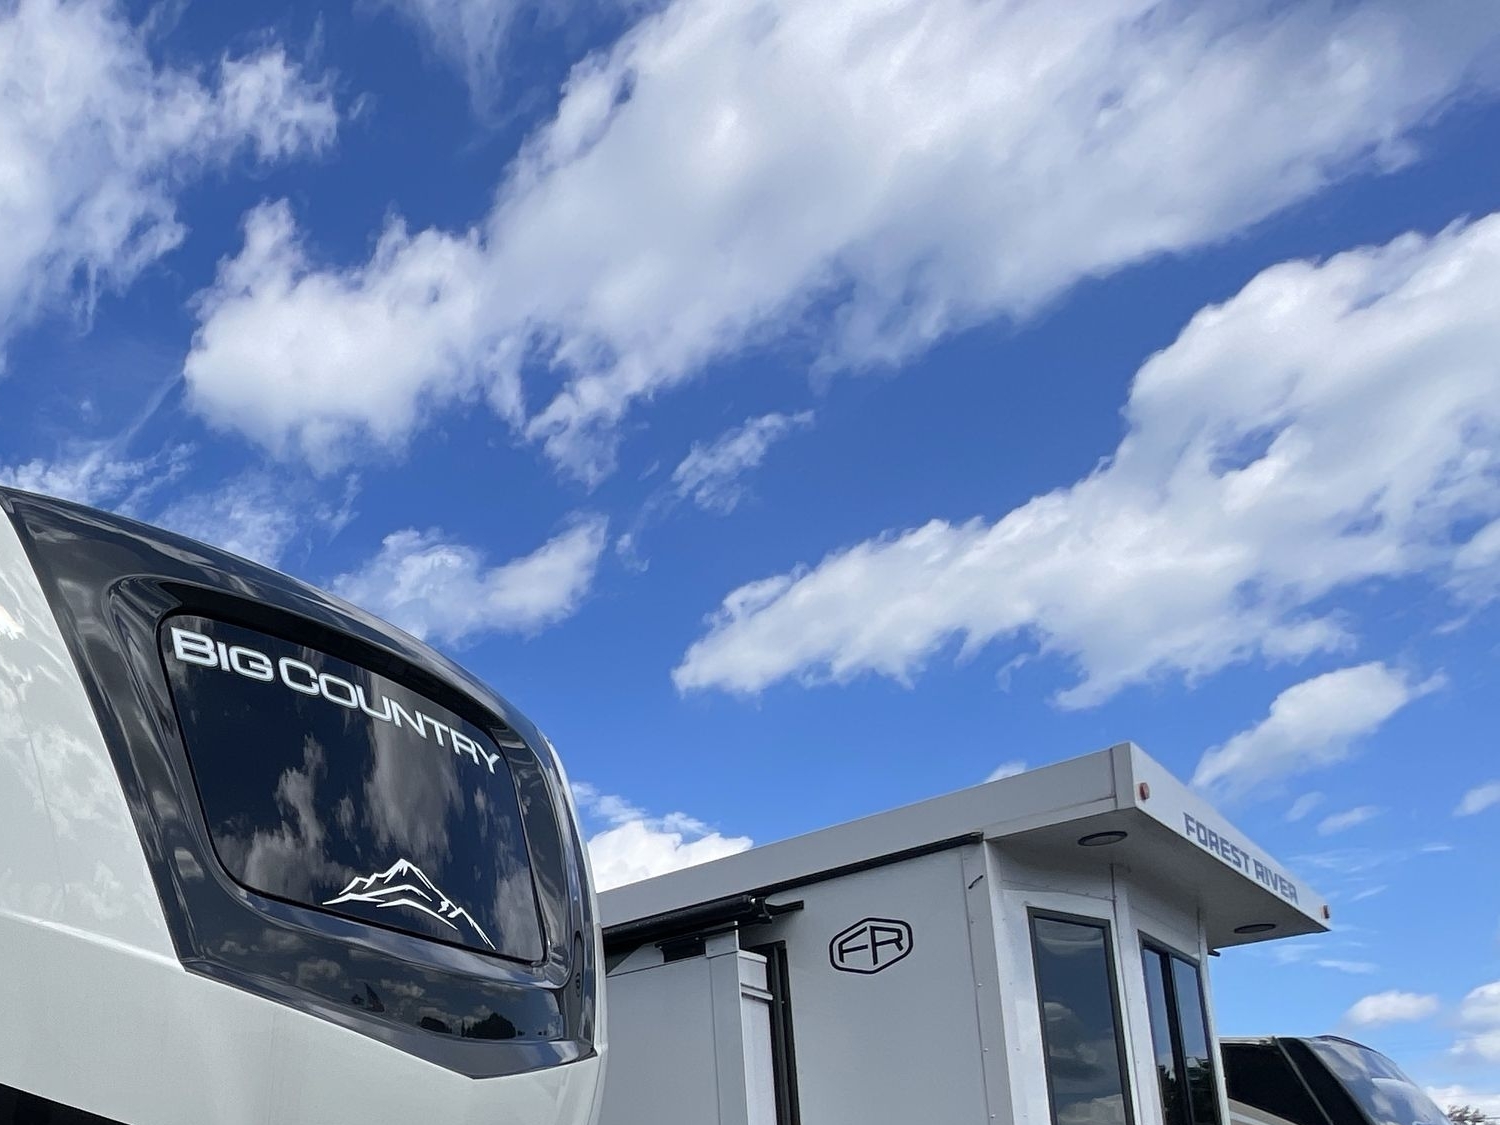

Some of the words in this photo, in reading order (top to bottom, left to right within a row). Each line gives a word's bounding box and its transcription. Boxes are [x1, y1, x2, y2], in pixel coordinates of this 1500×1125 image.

[170, 626, 275, 682] BIG
[279, 656, 501, 775] COUNTRY
[1183, 812, 1250, 873] FOREST
[1252, 858, 1300, 904] RIVER
[837, 925, 904, 967] FR
